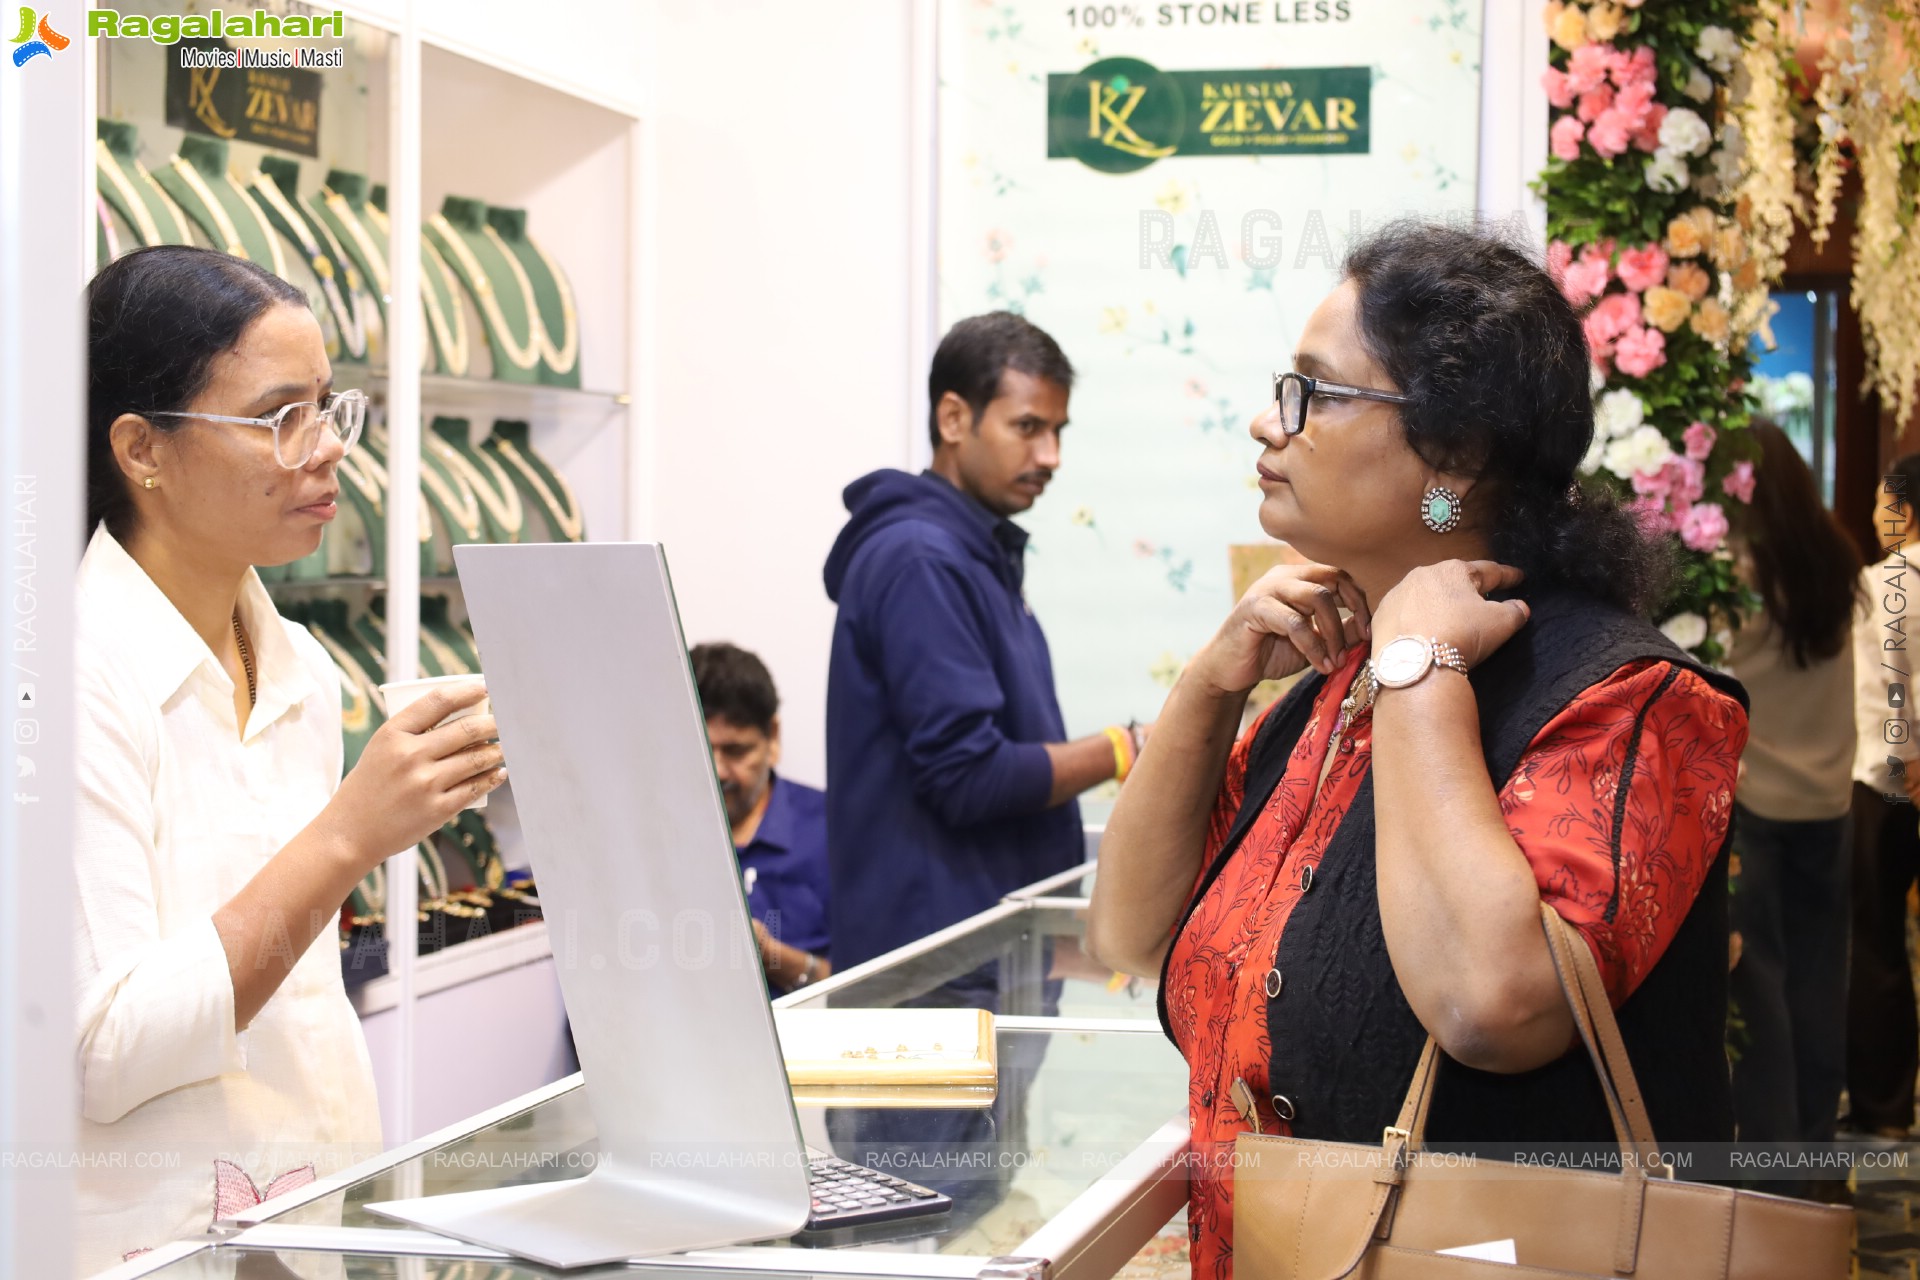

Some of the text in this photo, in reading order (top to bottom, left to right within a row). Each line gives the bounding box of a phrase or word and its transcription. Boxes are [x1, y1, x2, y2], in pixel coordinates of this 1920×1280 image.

[1066, 0, 1352, 28] 100% STONE LESS
[1200, 97, 1359, 133] ZEVAR
